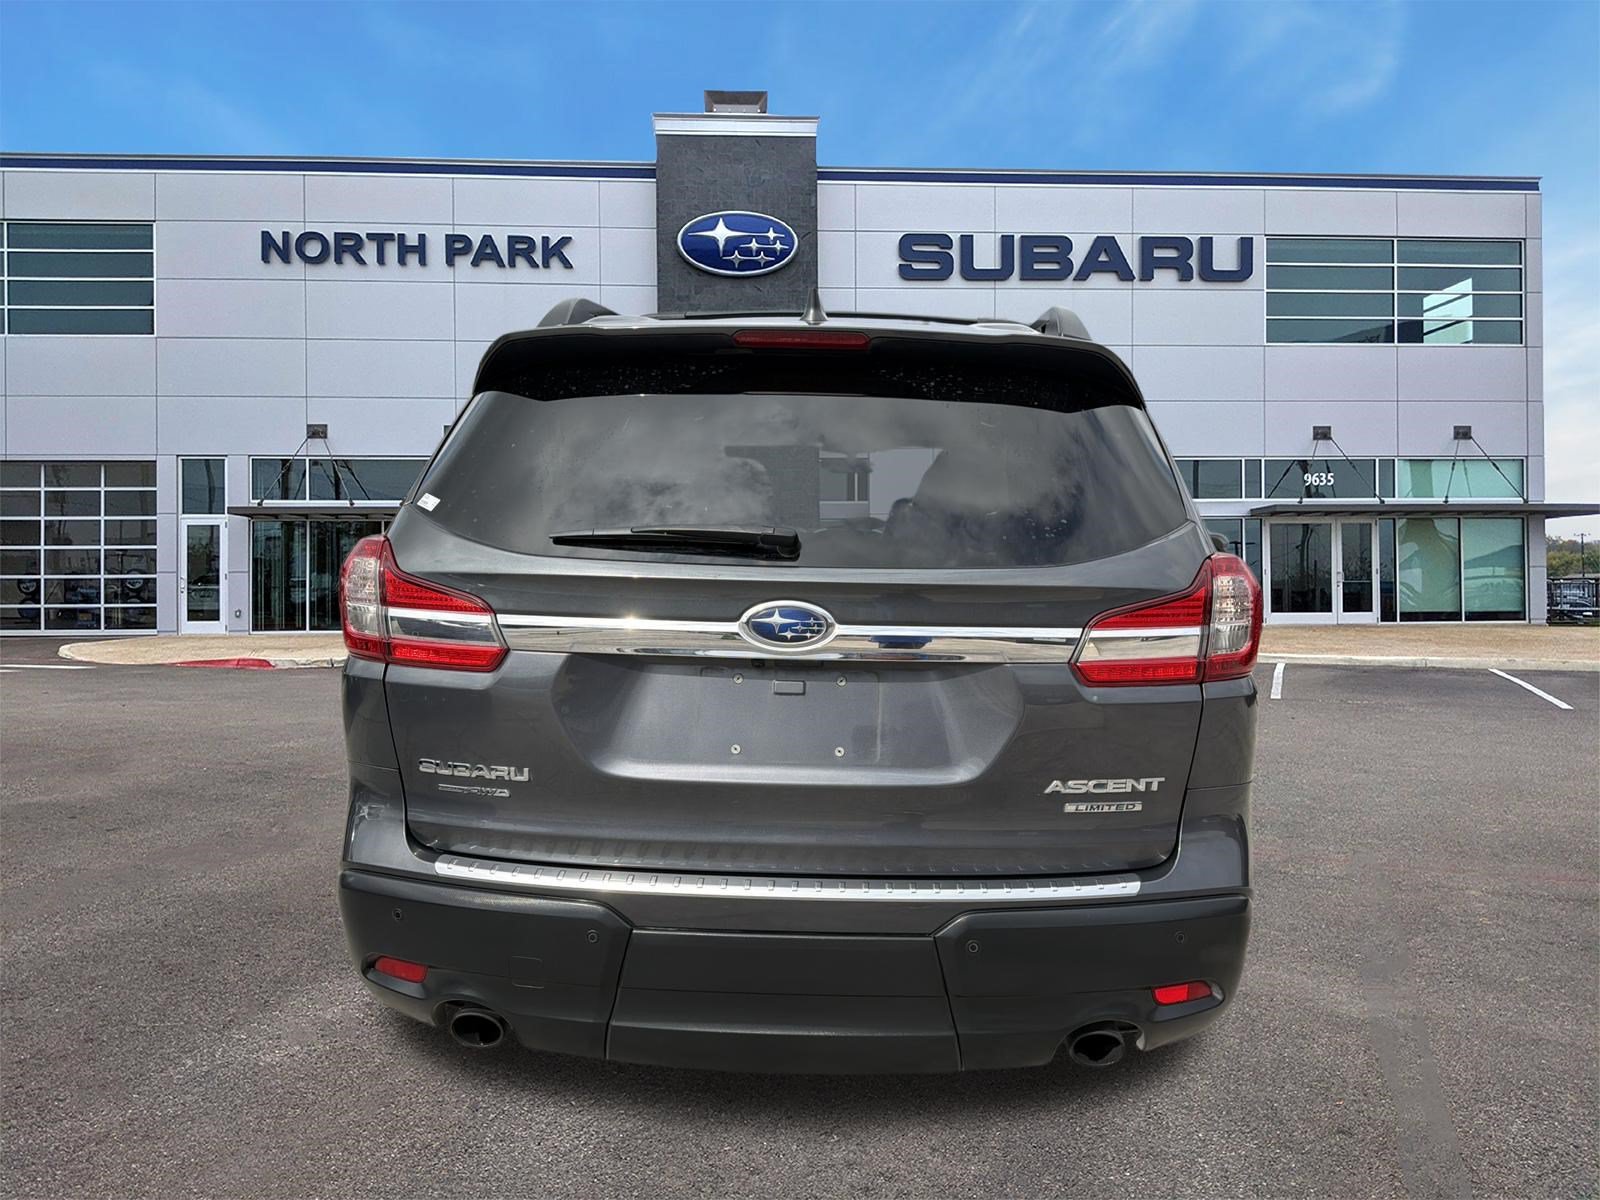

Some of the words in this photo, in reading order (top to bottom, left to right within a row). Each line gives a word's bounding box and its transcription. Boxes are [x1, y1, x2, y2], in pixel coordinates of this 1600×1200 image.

[261, 230, 427, 266] NORTH
[445, 233, 573, 269] PARK
[898, 233, 1254, 282] SUBARU
[1303, 472, 1335, 486] 9635
[418, 757, 530, 782] SUBARU
[1043, 777, 1166, 794] ASCENT
[1073, 803, 1137, 812] LIMITED
